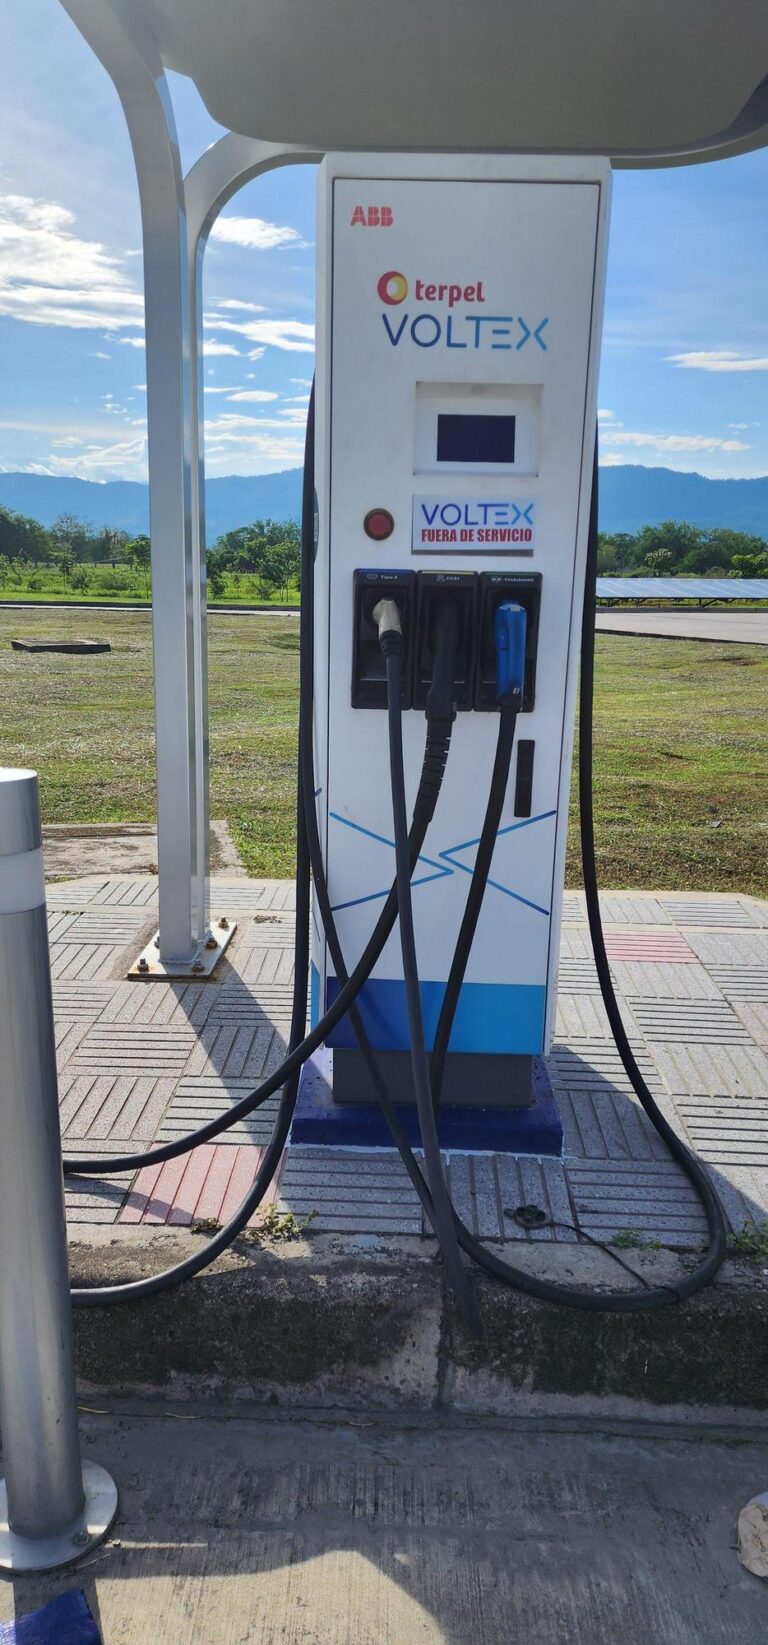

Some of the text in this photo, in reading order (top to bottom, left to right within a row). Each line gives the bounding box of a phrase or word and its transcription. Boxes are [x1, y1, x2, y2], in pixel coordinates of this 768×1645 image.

[350, 206, 394, 227] ABB
[415, 280, 485, 308] terpel
[382, 313, 549, 351] VOLTEX
[421, 503, 534, 526] VOLTEX
[421, 528, 533, 543] FUERA DE SERVICIO
